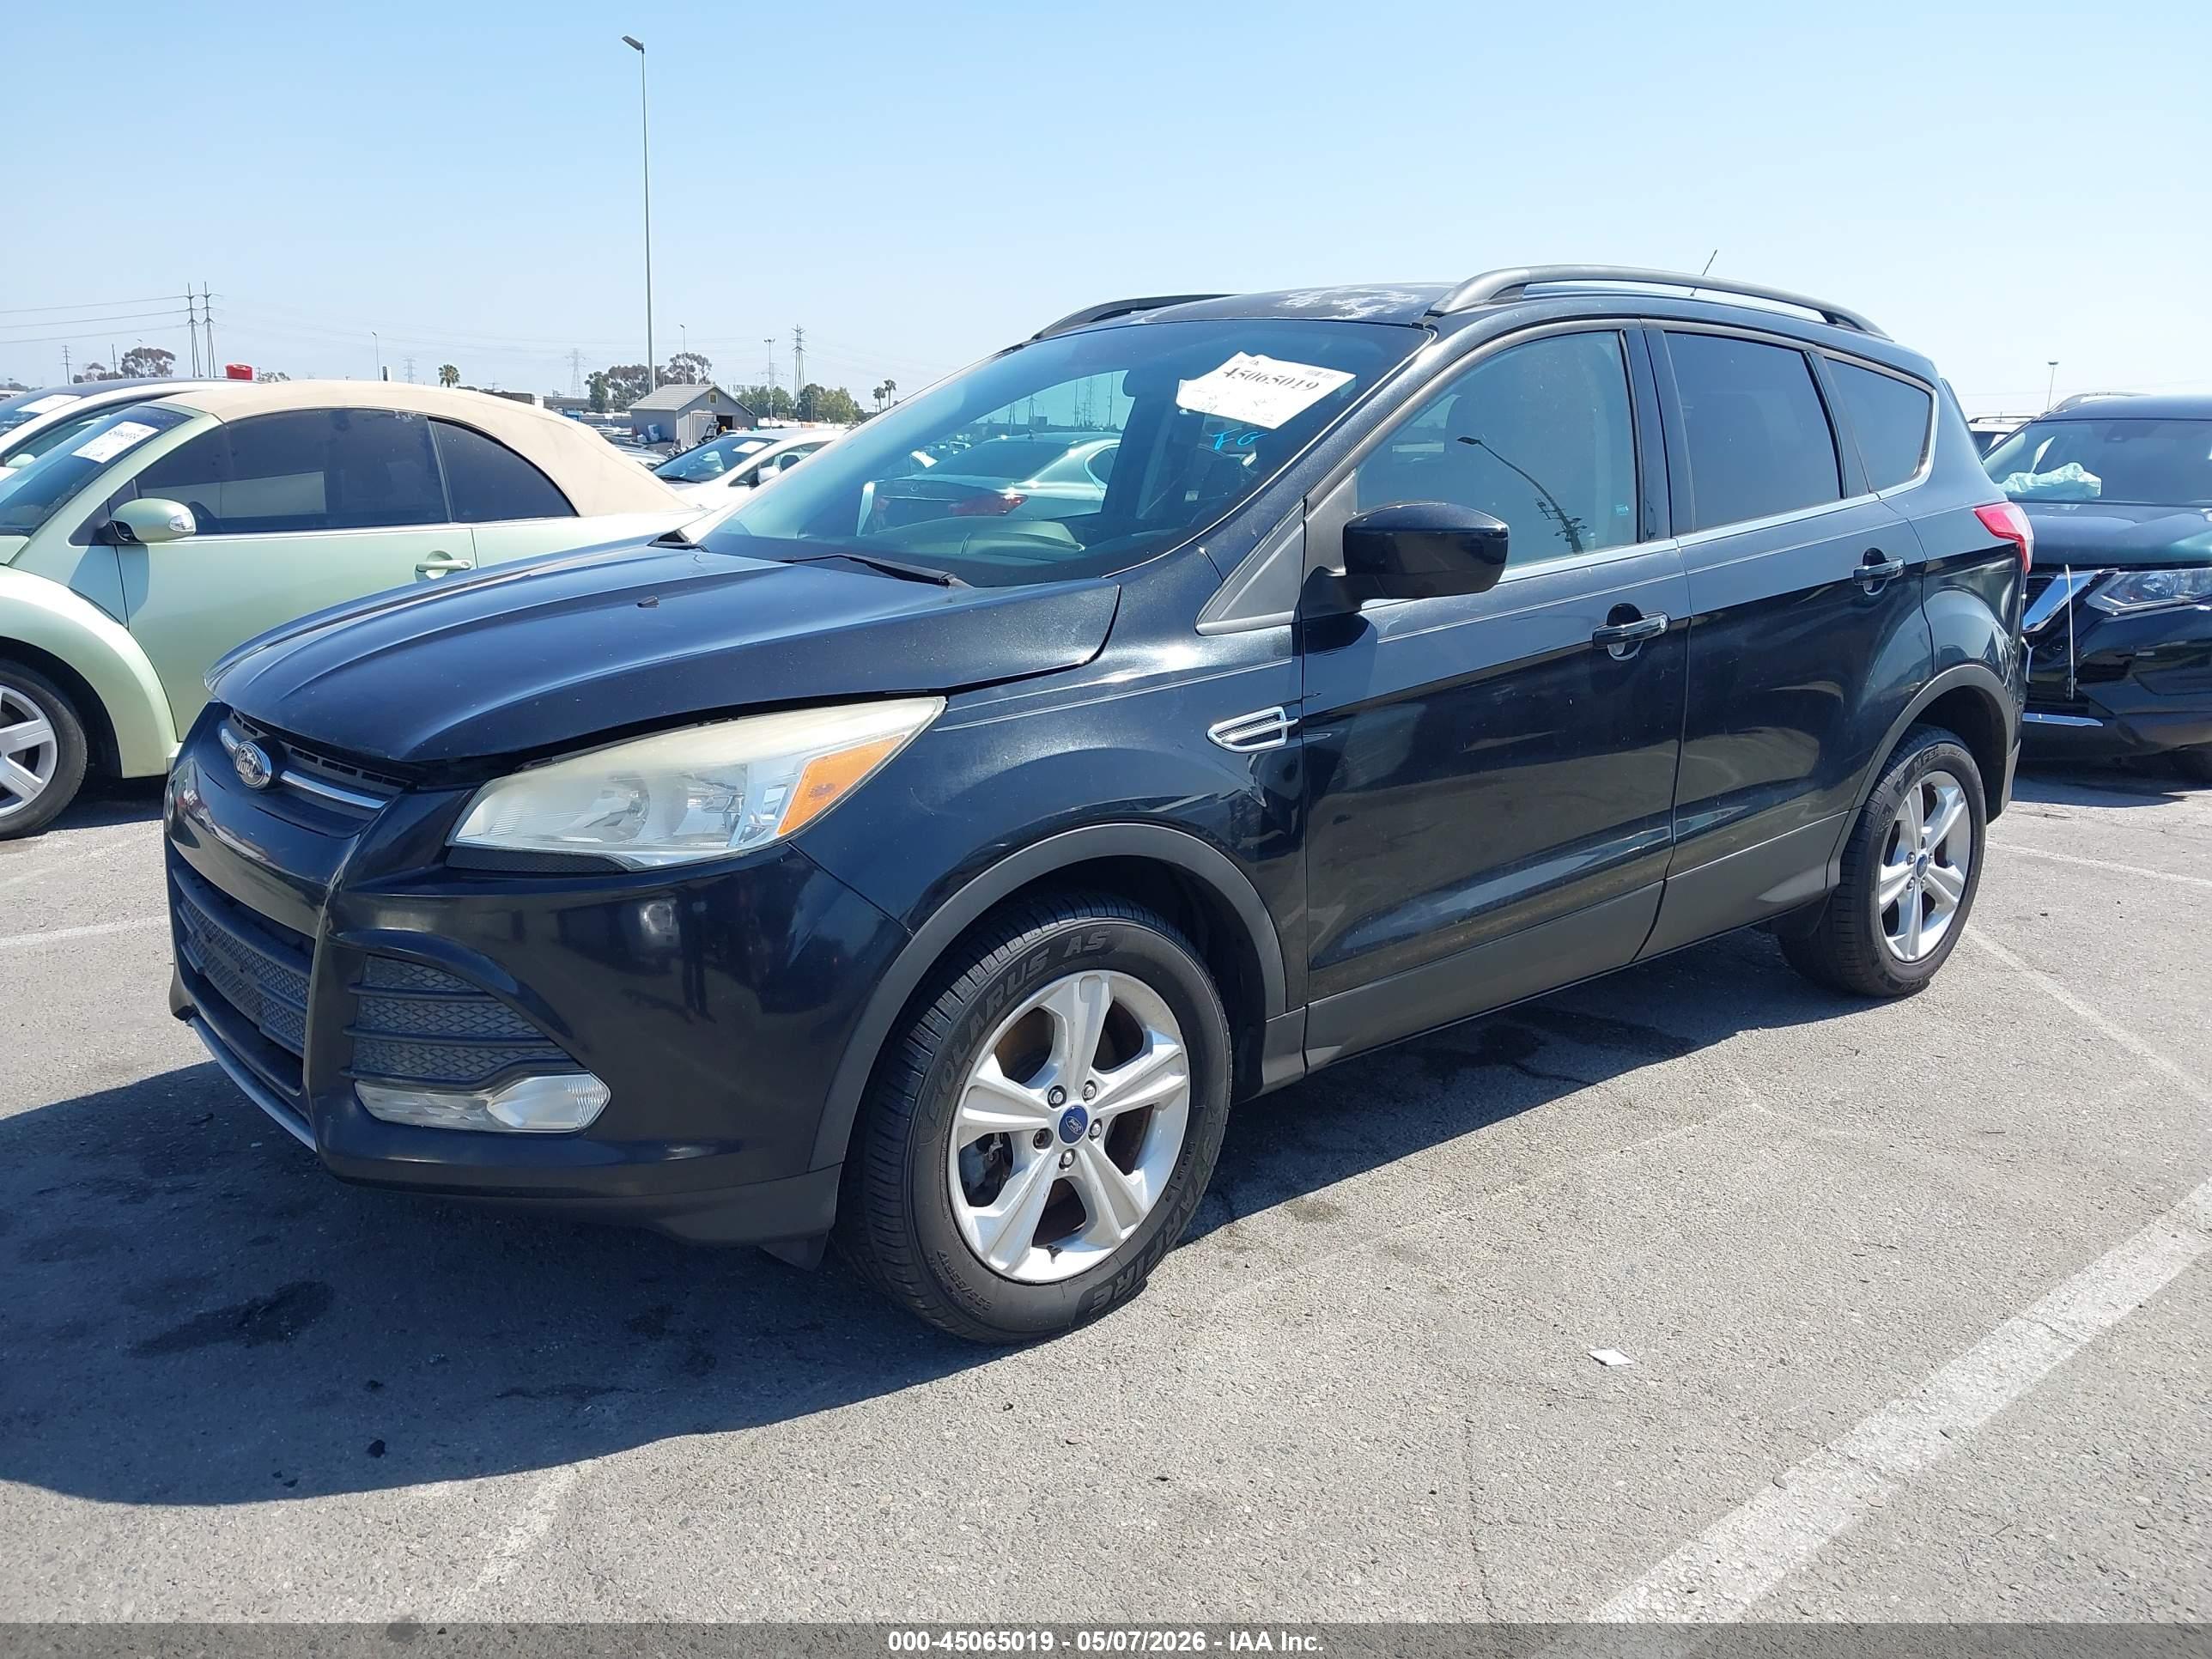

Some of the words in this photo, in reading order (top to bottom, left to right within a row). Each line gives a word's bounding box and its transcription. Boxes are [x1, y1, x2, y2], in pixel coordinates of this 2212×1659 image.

[1223, 367, 1320, 392] 45065019
[928, 947, 1050, 1121] SOLARUS
[1063, 931, 1109, 957] AS
